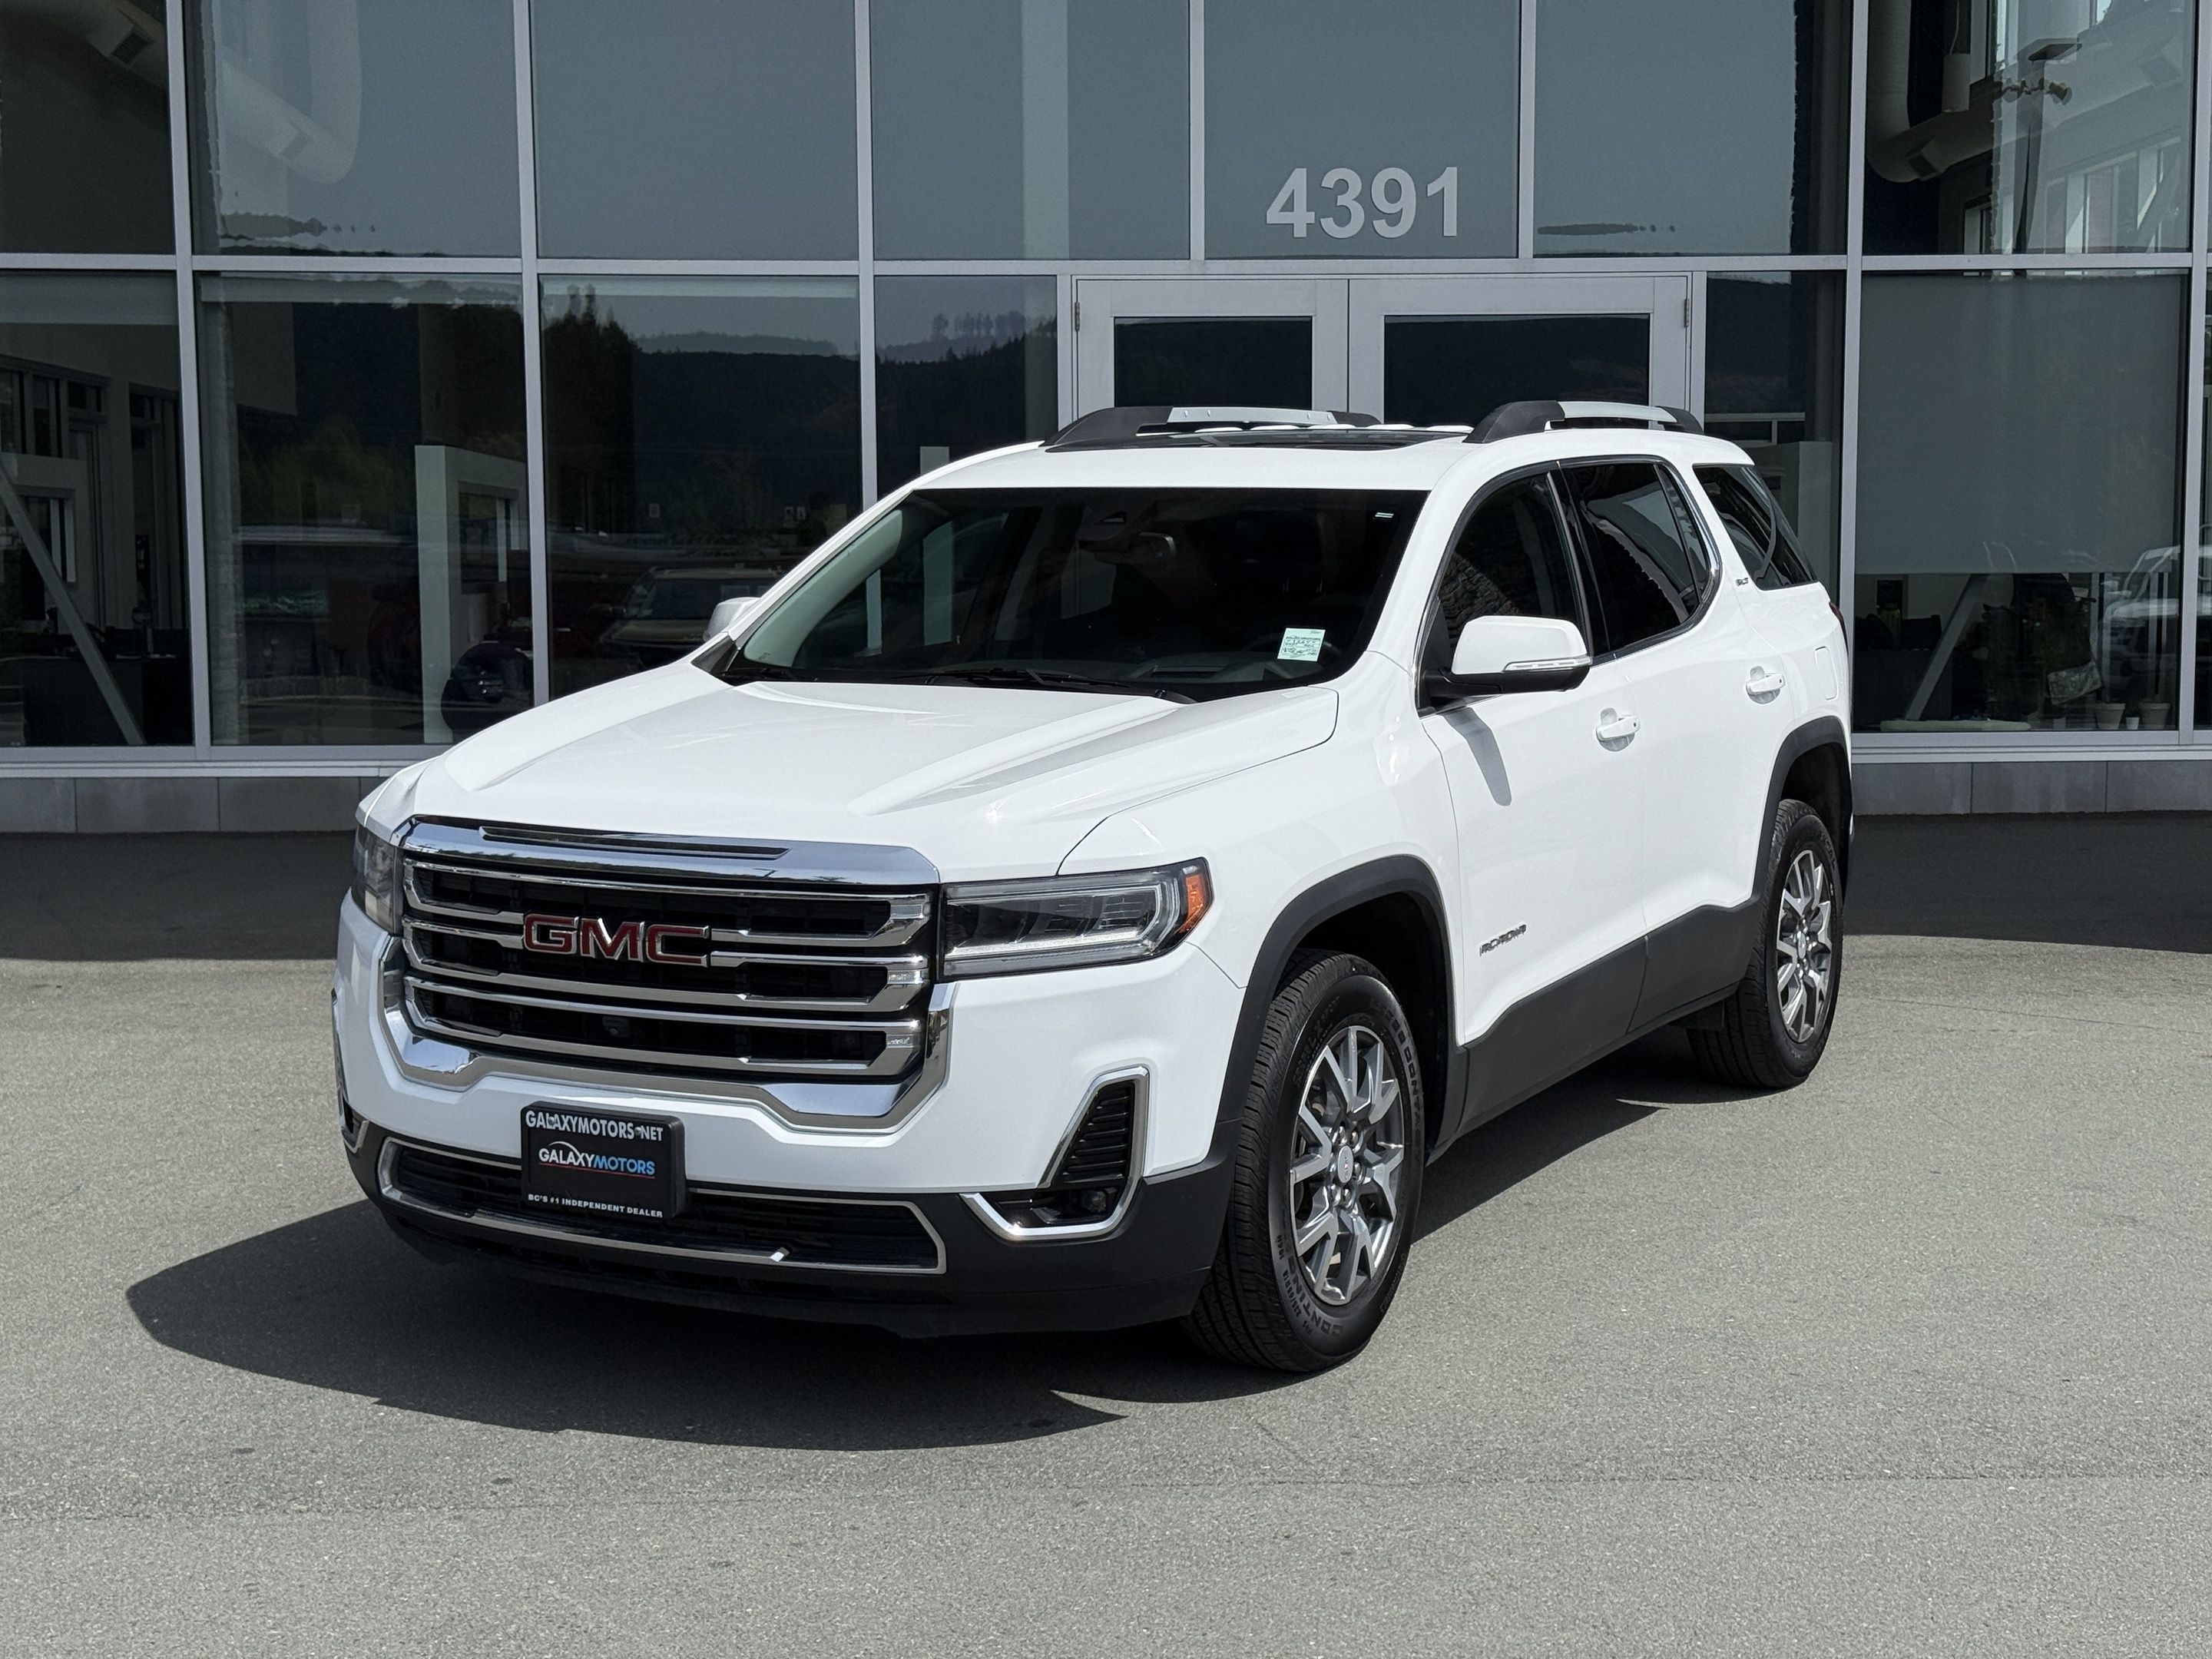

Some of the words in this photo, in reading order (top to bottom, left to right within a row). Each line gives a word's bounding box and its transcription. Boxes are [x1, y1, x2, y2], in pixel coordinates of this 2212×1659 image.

[1266, 167, 1458, 238] 4391
[524, 913, 710, 968] GMC
[525, 1111, 664, 1141] GALAXYMOTORSNET
[539, 1147, 655, 1174] GALAXYMOTORS
[528, 1194, 548, 1203] BC'S
[562, 1198, 624, 1213] INDEPENDENT
[628, 1207, 663, 1218] DEALER
